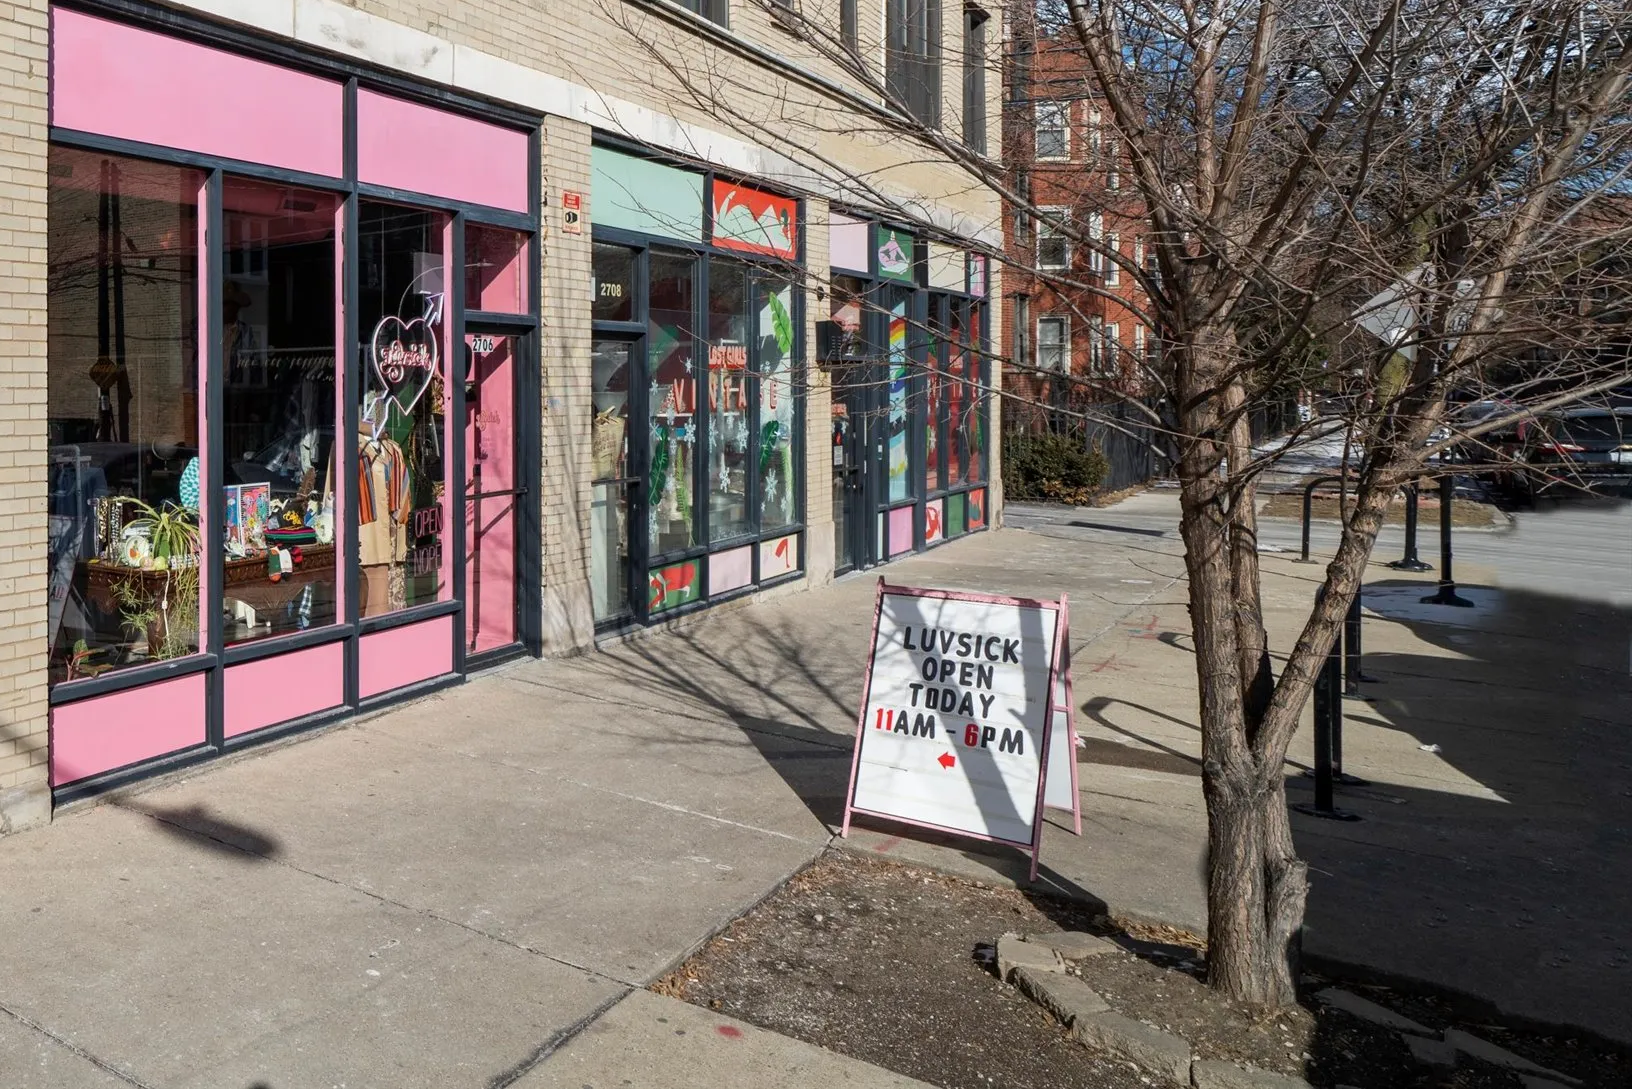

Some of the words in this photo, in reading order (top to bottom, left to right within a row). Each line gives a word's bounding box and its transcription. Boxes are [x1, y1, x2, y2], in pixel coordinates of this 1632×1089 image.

[600, 282, 622, 297] 2708
[472, 338, 494, 352] 2706
[415, 506, 443, 538] OPEN
[414, 544, 442, 576] NOPE
[903, 626, 1020, 664] LUVSICK
[921, 657, 994, 690] OPEN
[909, 683, 995, 719] TODAY
[875, 707, 936, 739] 11AM
[964, 723, 1024, 755] 6PM
